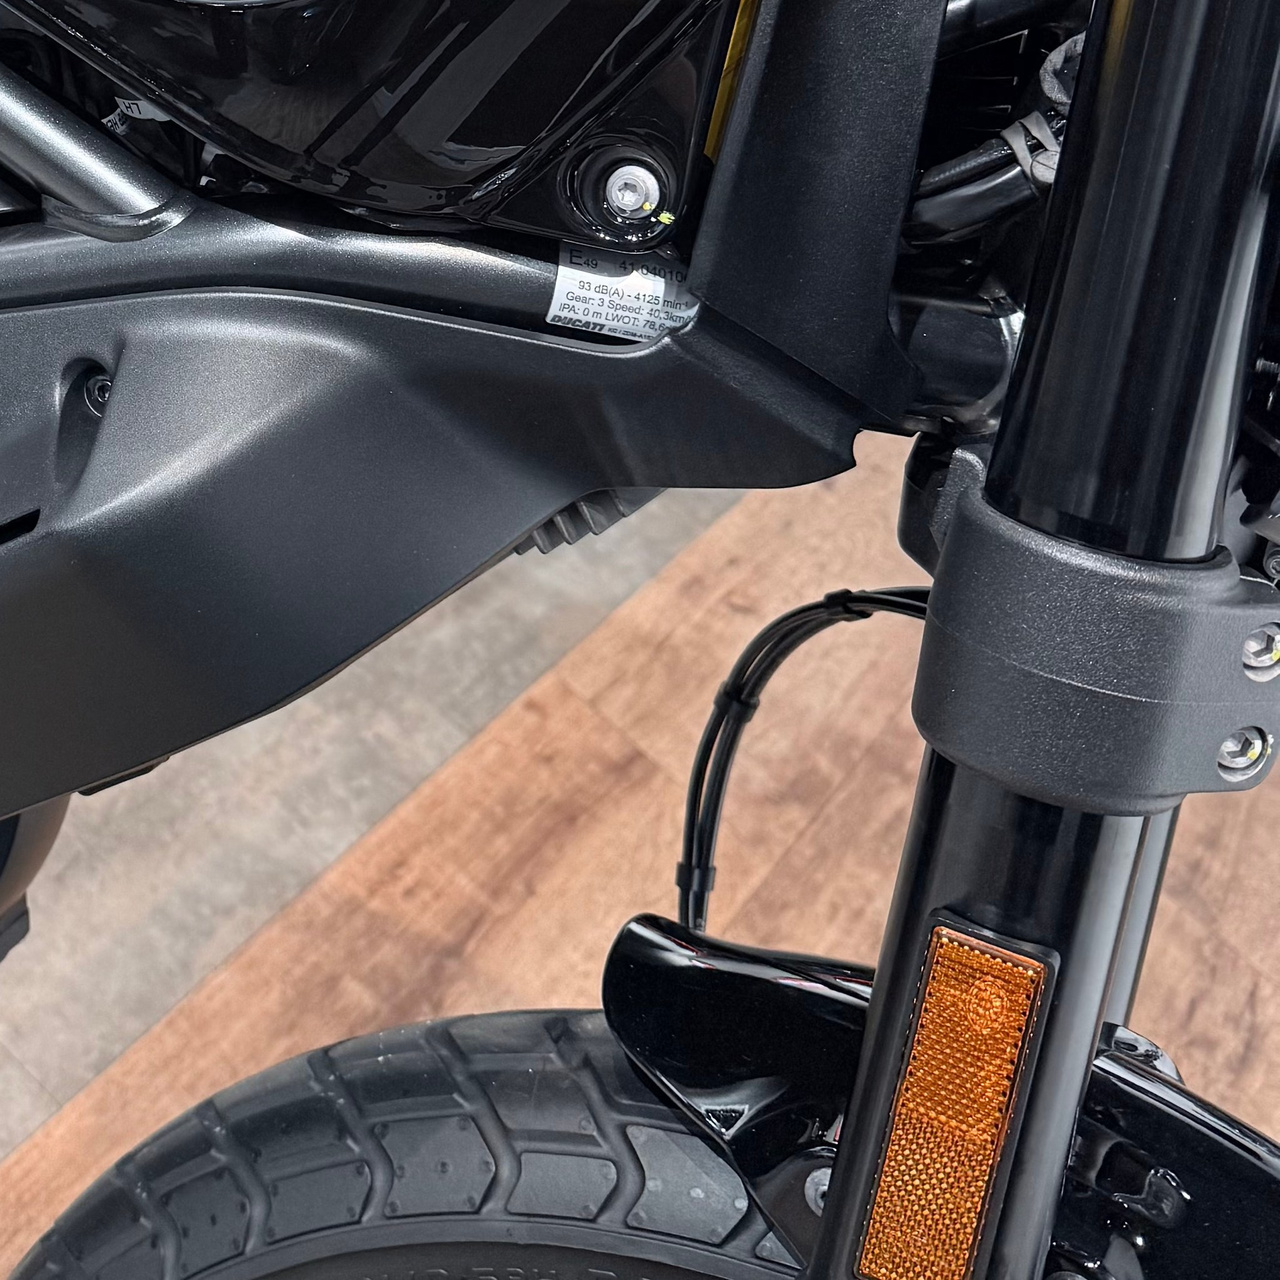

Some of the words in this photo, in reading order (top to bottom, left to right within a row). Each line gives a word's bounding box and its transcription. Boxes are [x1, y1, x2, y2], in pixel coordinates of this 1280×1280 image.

[578, 280, 592, 292] 93
[594, 284, 625, 300] dB(A)
[633, 292, 661, 306] 4125
[591, 310, 603, 320] m
[597, 296, 605, 308] 3
[607, 299, 644, 317] Speed:
[550, 314, 607, 332] DUCATI
